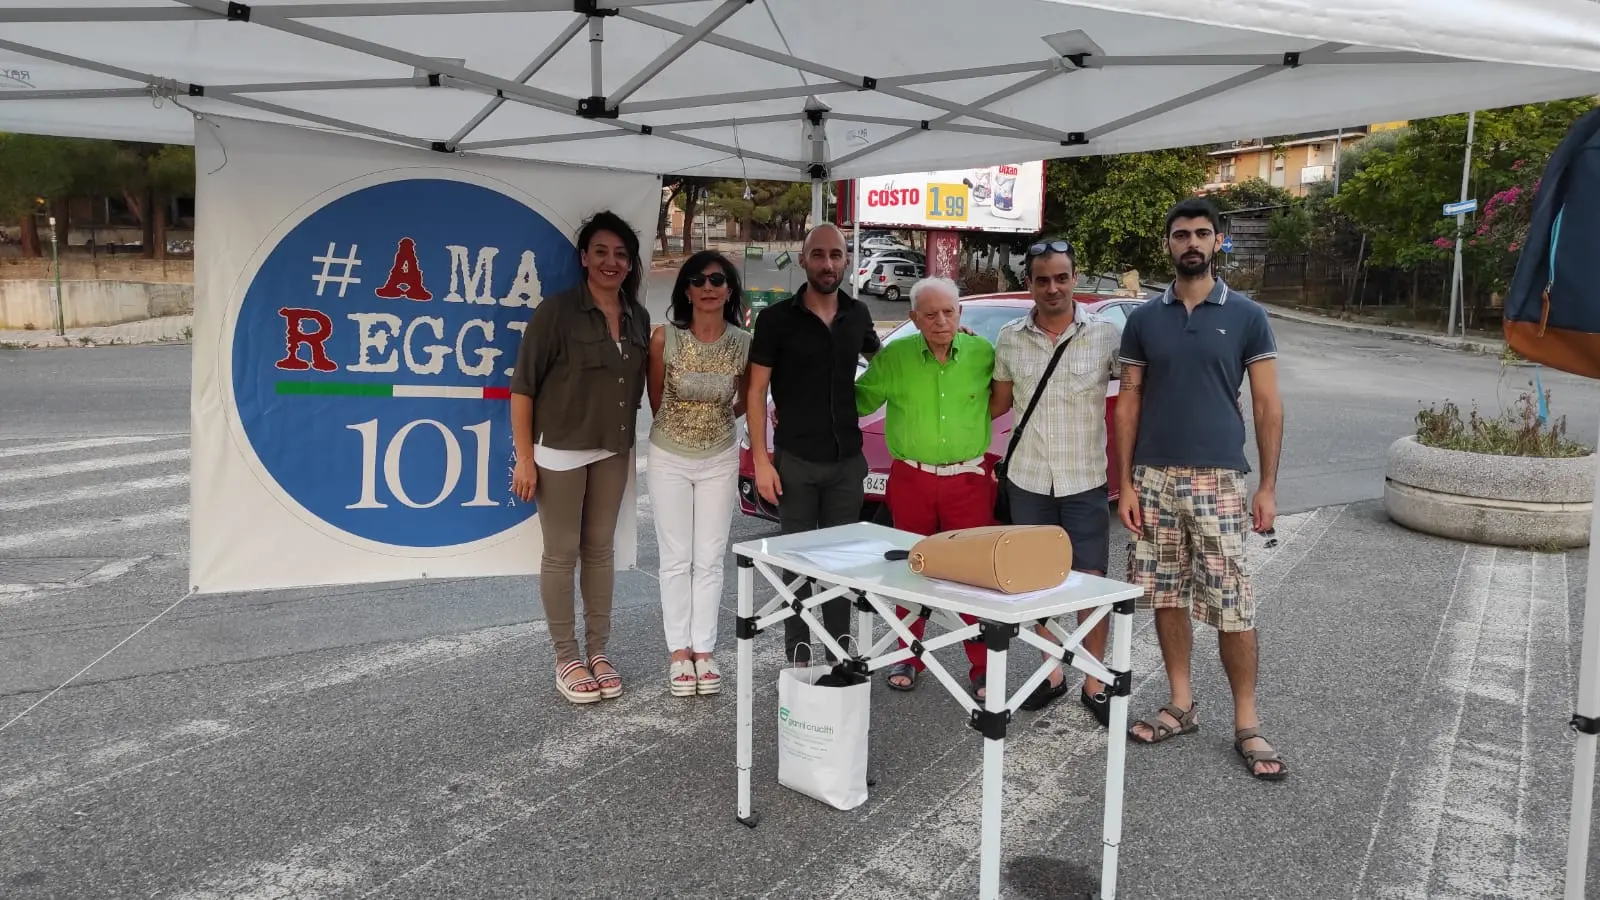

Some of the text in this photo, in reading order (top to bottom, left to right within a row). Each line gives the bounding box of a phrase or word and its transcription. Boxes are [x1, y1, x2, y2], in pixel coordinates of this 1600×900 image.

[867, 188, 919, 207] COSTO
[345, 418, 499, 509] 101
[867, 477, 888, 491] 843
